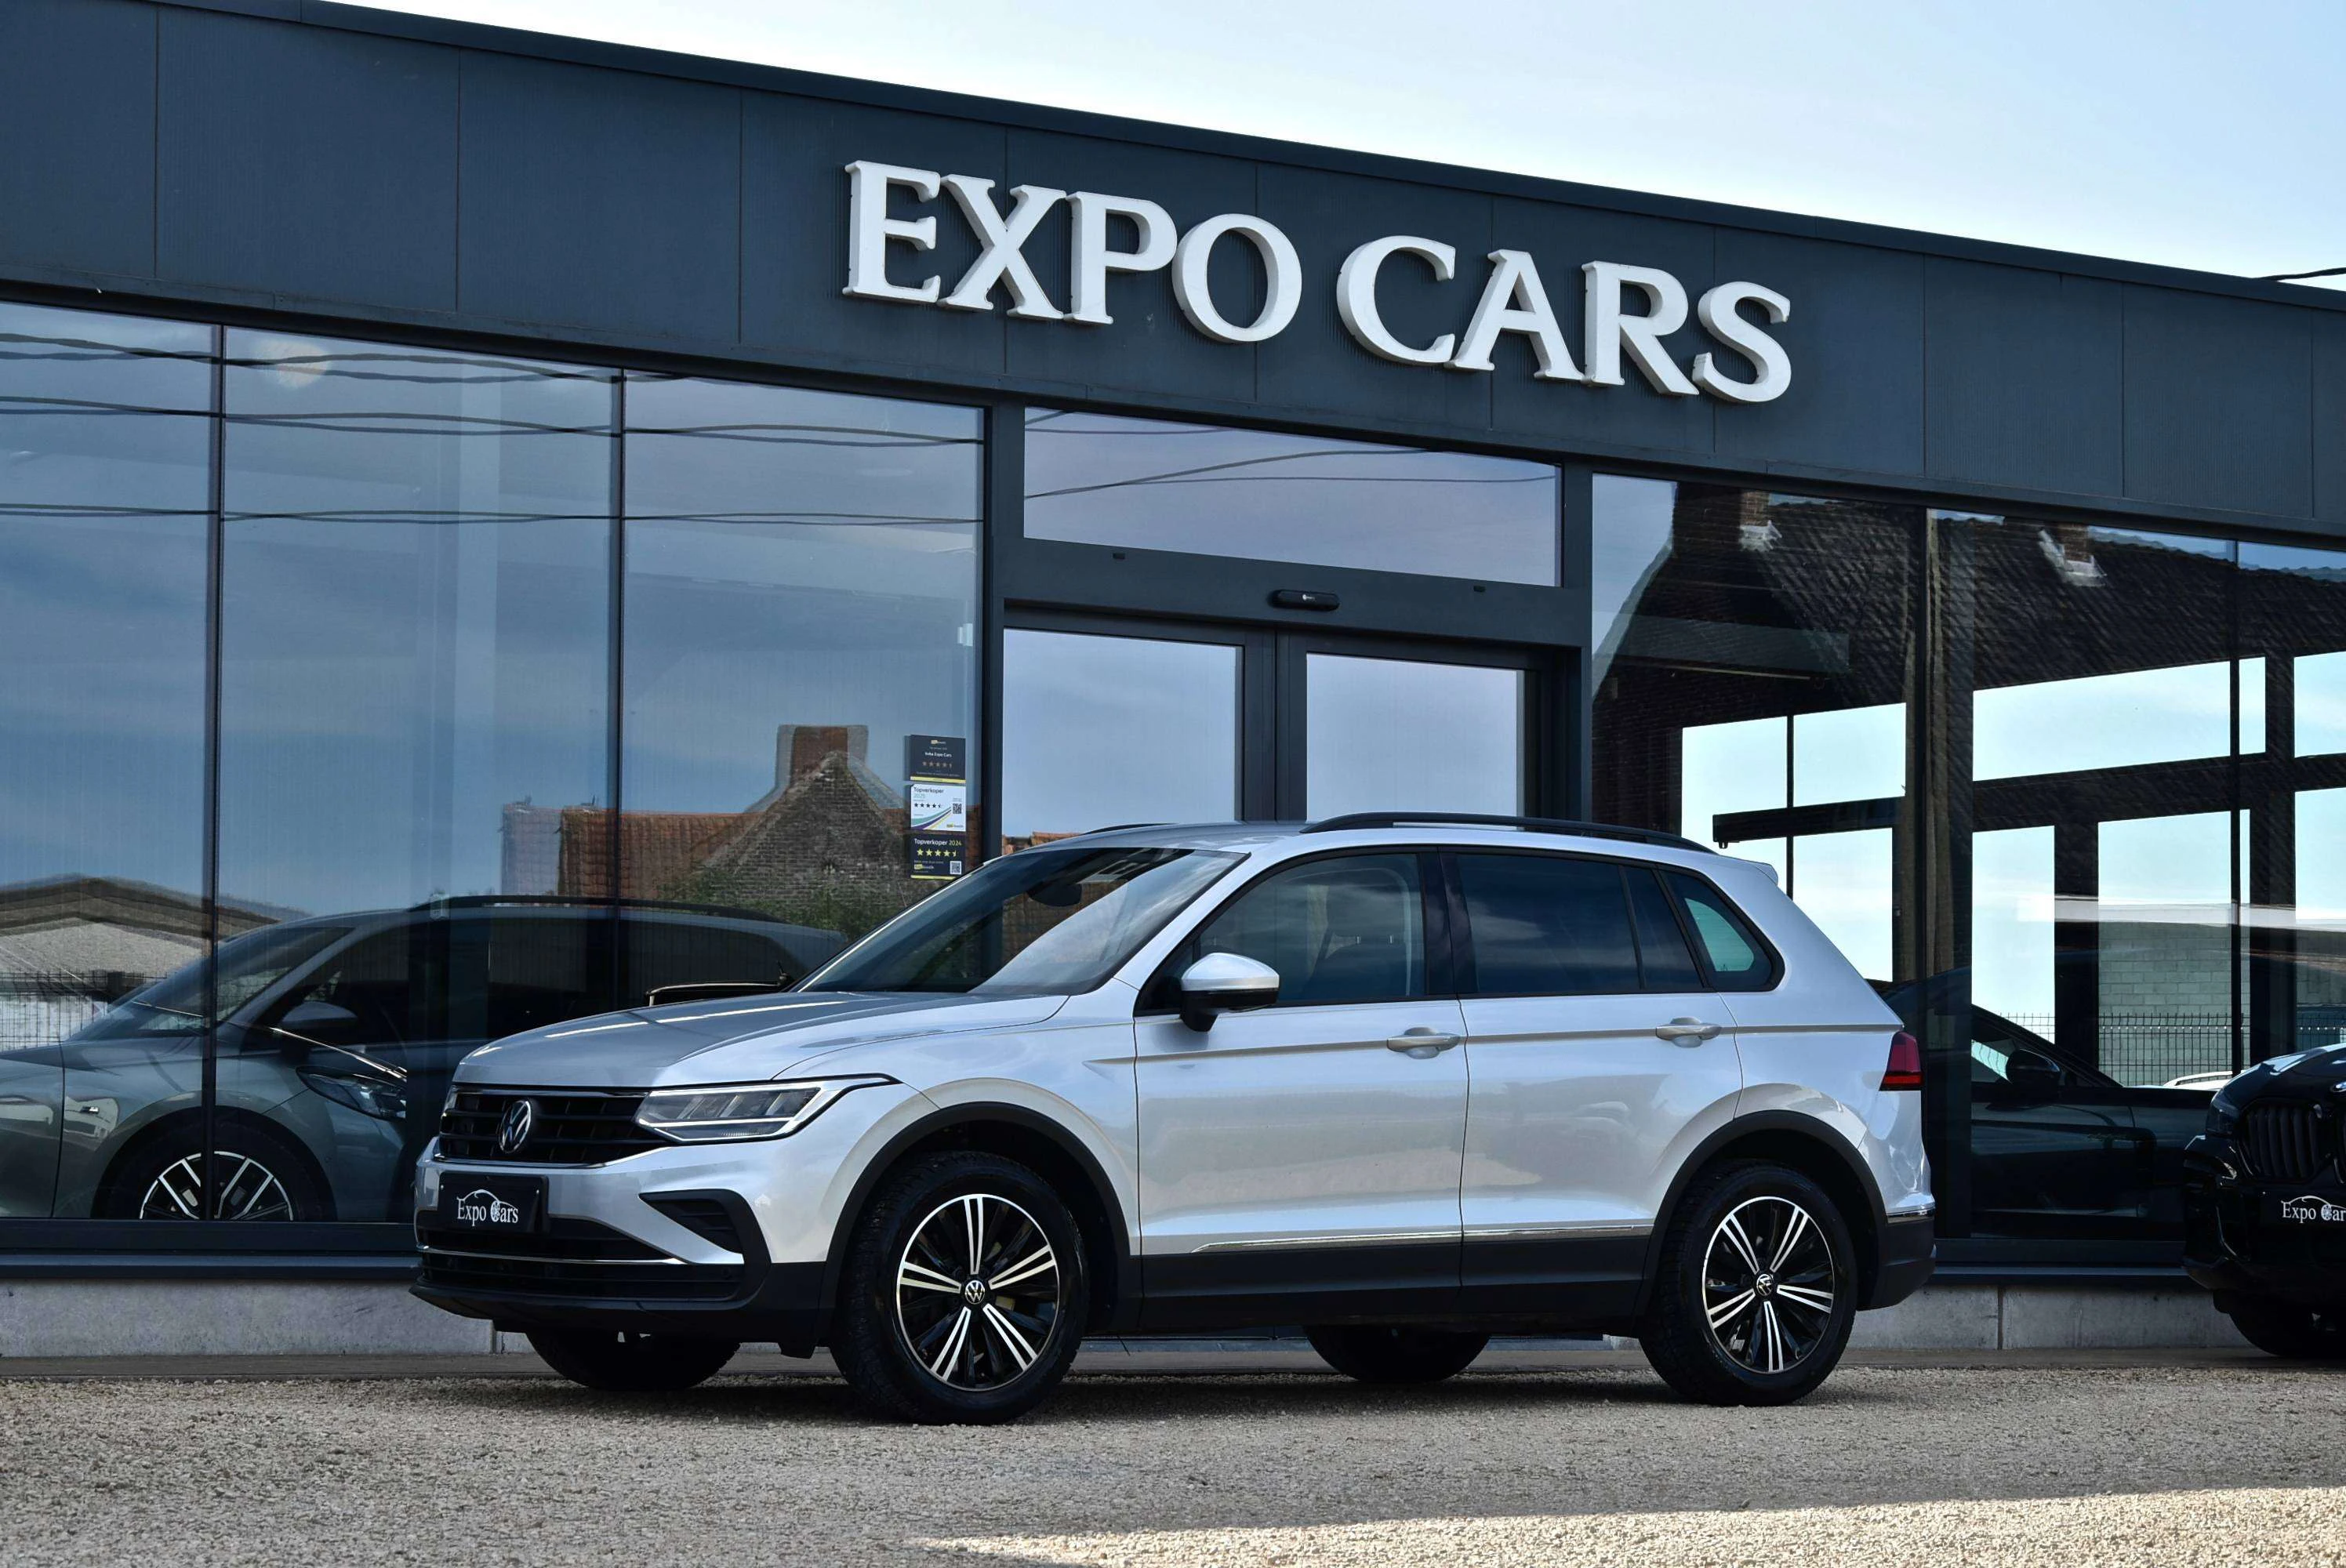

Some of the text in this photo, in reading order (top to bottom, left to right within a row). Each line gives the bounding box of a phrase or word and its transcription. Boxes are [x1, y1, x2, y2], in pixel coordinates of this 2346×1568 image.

[842, 160, 1791, 403] EXPO CARS
[914, 838, 948, 847] Topverkoper
[457, 1196, 518, 1227] Expo Cars
[2281, 1200, 2316, 1224] Expo
